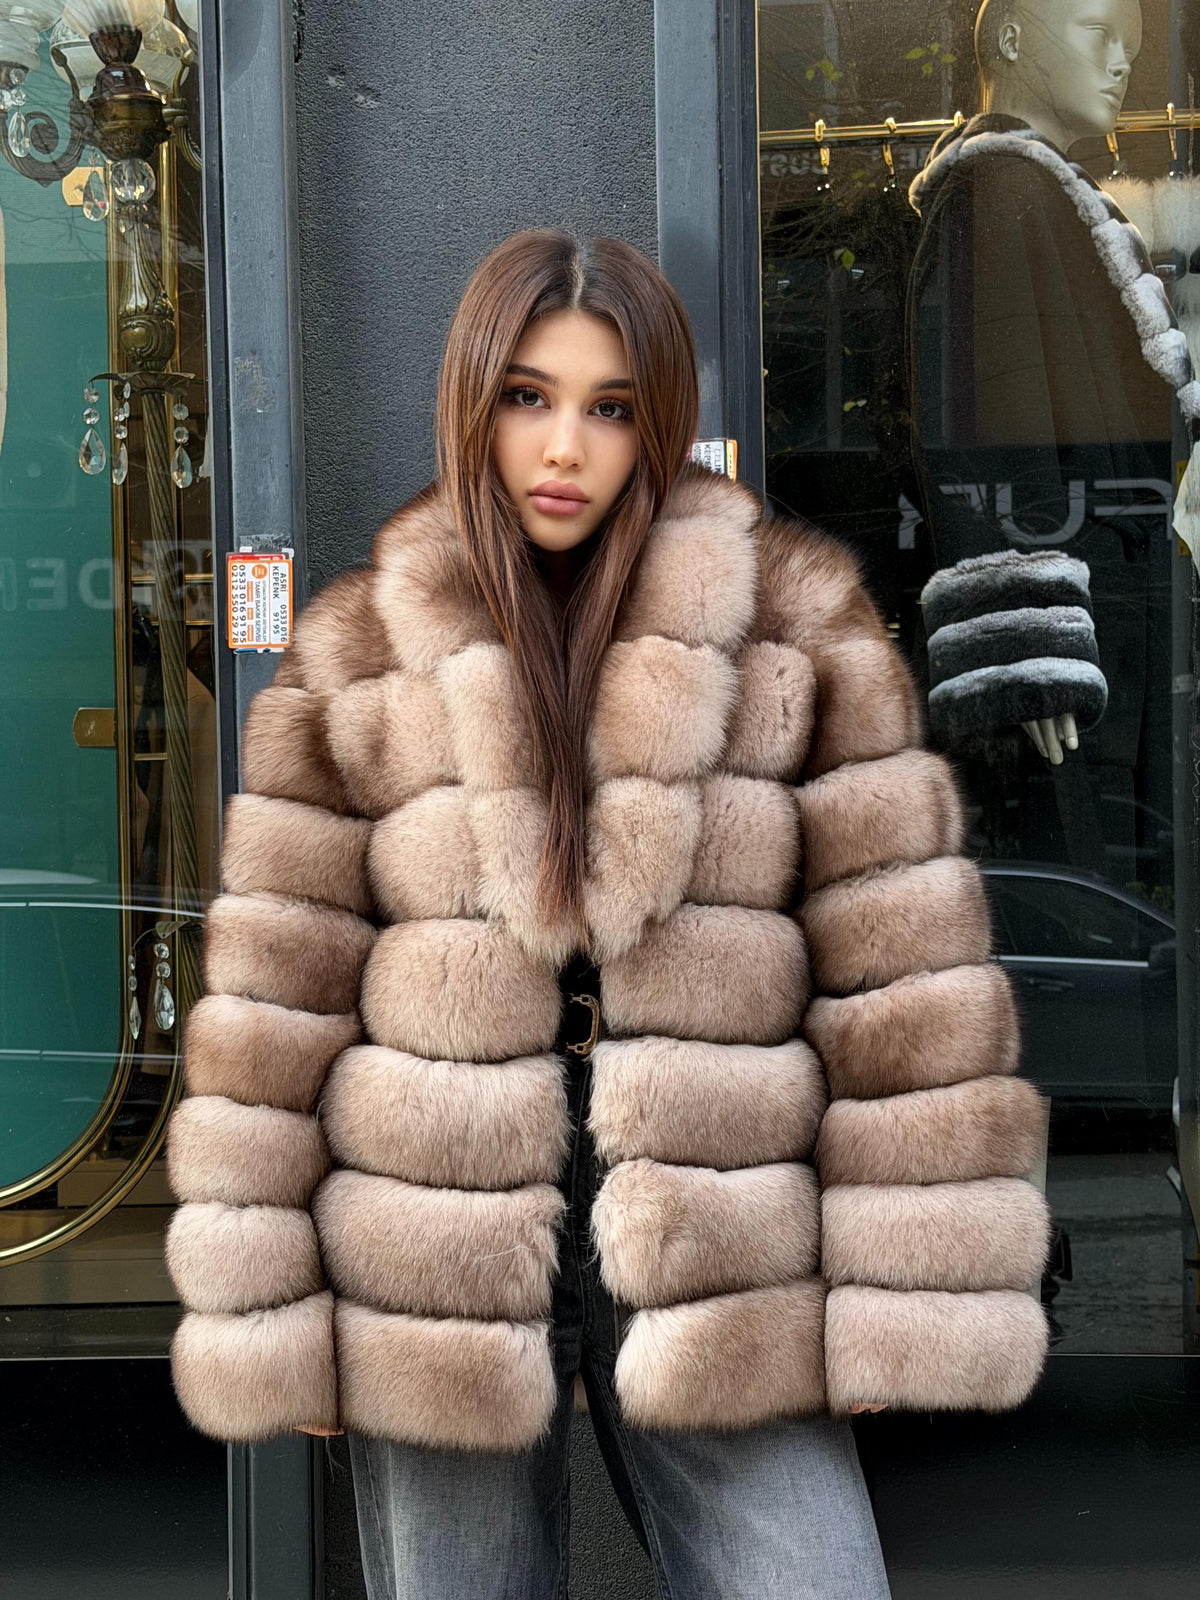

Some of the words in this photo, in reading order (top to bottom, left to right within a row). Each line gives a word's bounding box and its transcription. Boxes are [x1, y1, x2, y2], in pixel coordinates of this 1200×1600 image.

[231, 565, 239, 590] 0212
[272, 565, 280, 599] KEPENK
[231, 594, 239, 613] 550
[231, 616, 239, 628] 29
[239, 615, 247, 627] 91
[231, 631, 239, 644] 78
[239, 630, 247, 643] 95
[280, 627, 288, 643] 016
